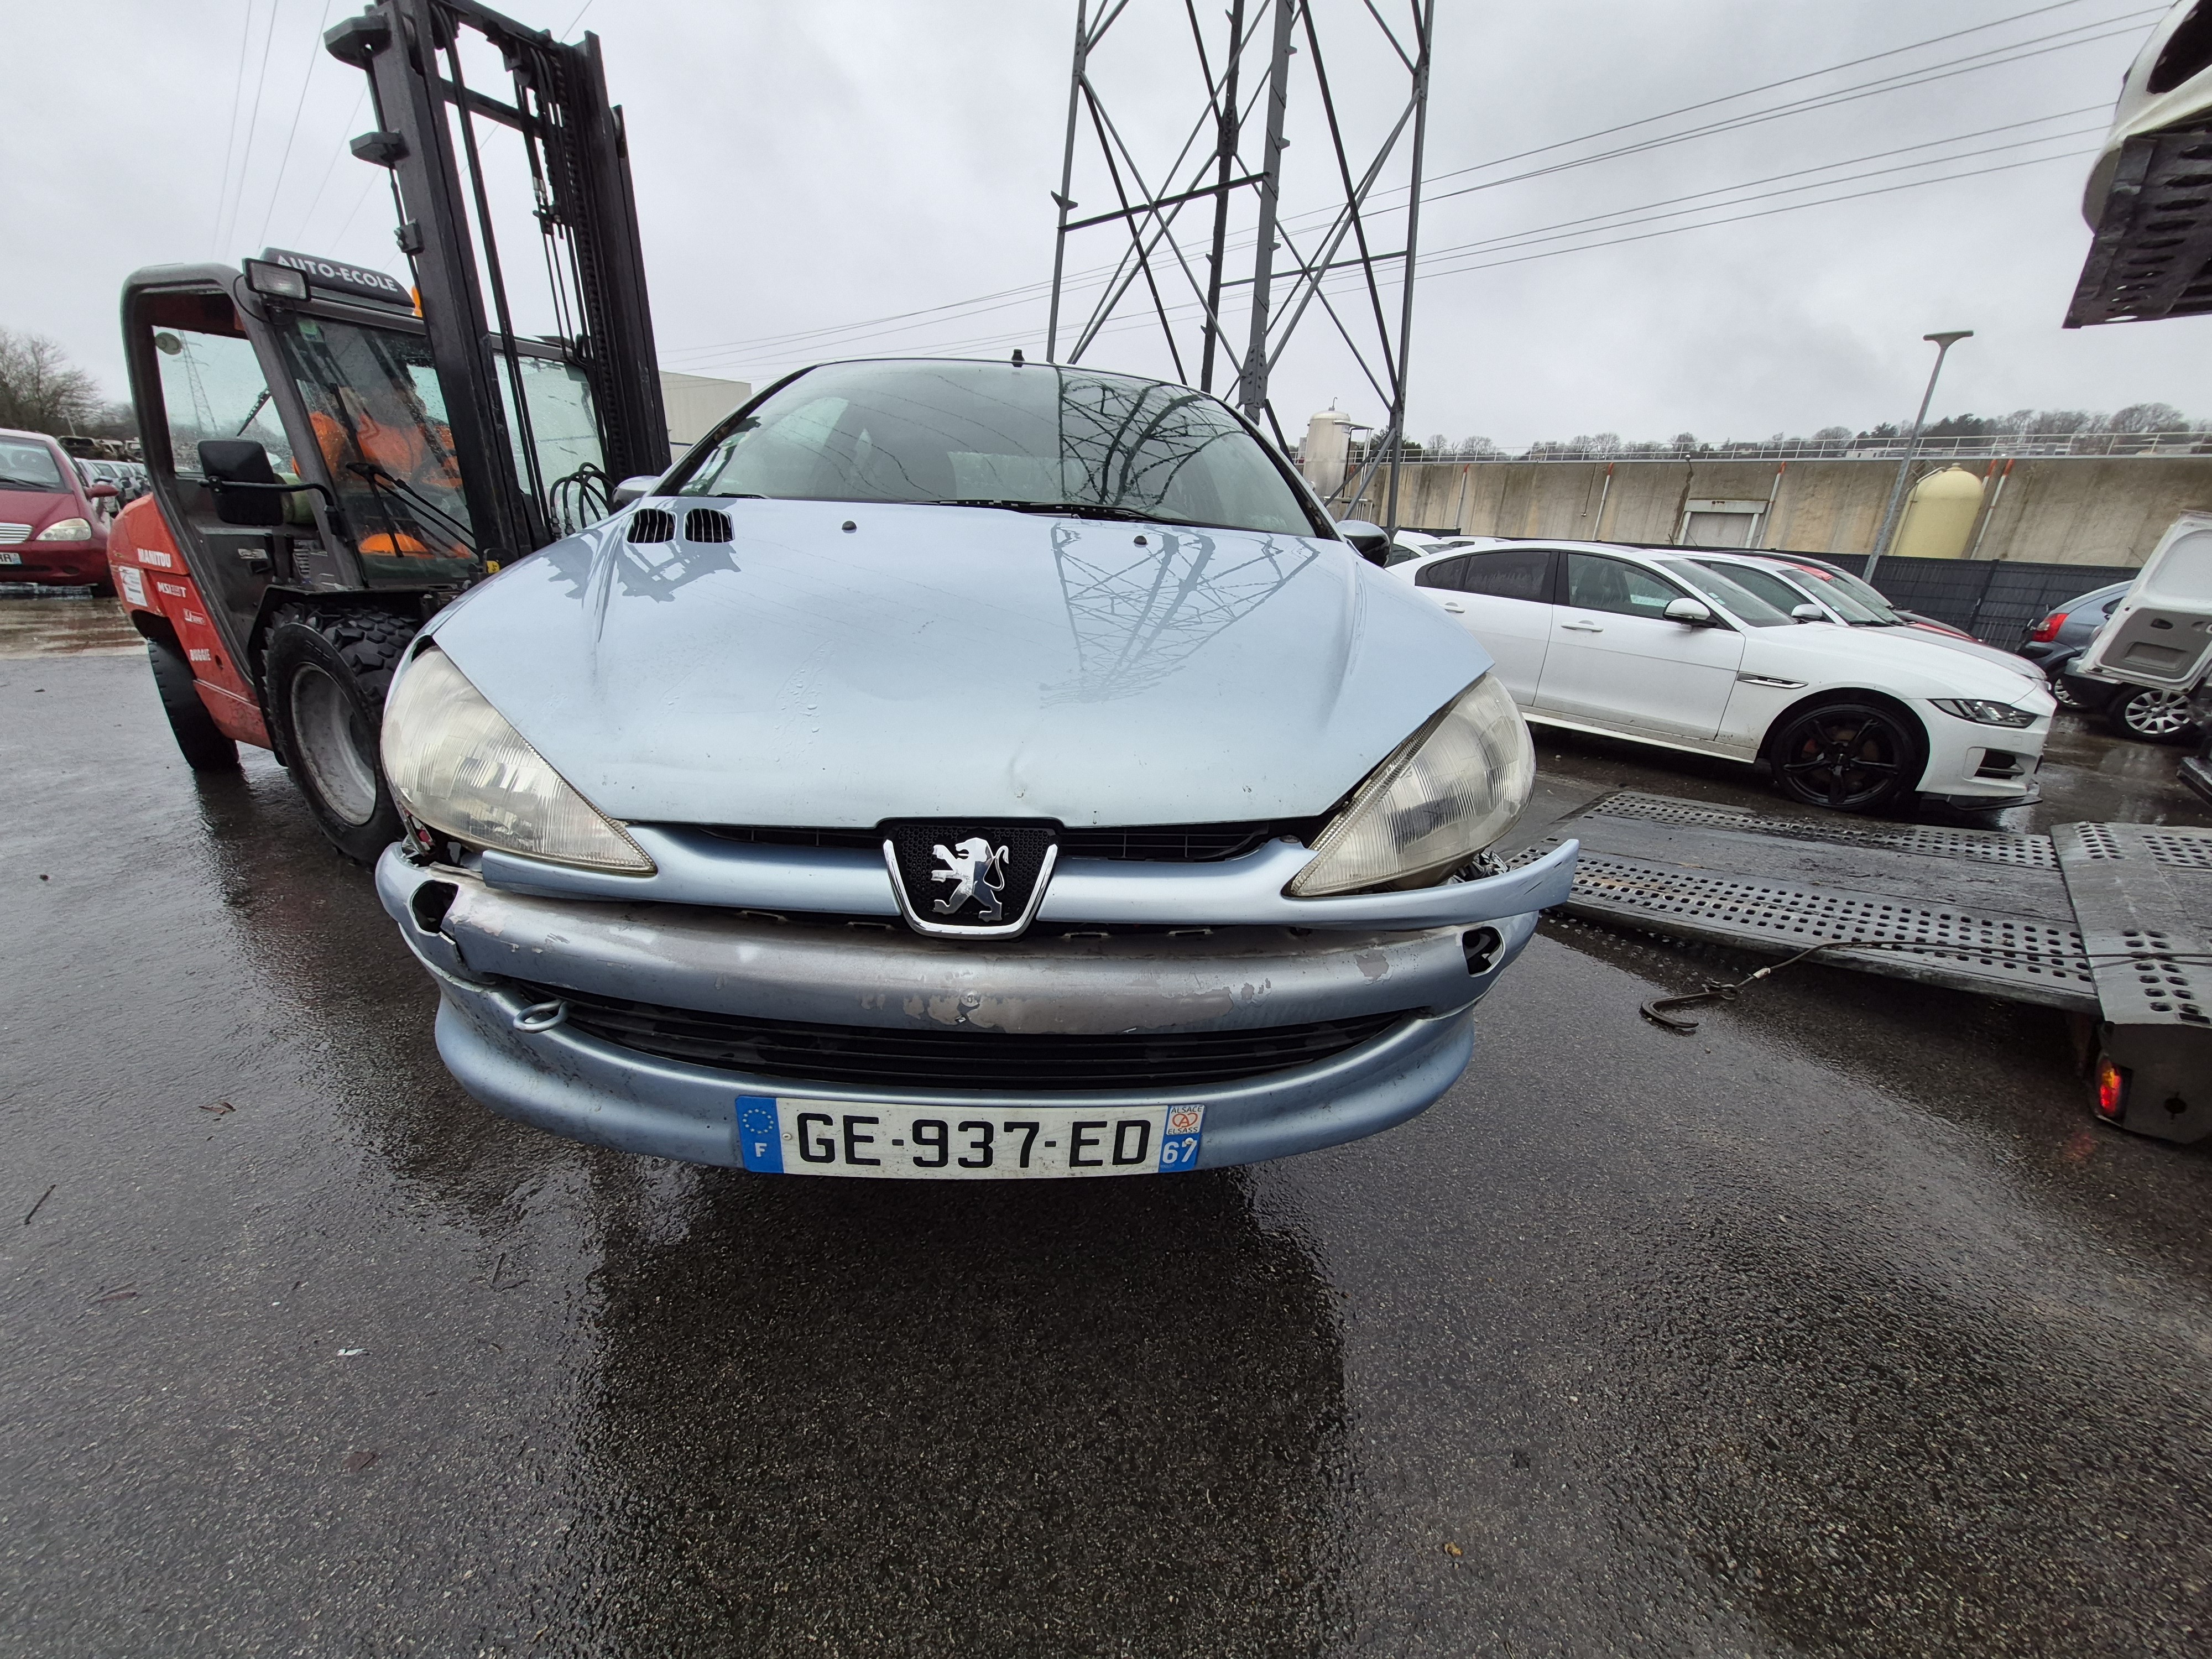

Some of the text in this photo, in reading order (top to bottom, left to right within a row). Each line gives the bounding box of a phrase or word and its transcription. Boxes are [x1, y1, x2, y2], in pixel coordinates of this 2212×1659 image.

[278, 255, 398, 292] AUTO-ECOLE
[137, 547, 171, 568] MANITOU
[754, 1142, 767, 1157] F
[797, 1112, 1152, 1168] GE-937-ED
[1162, 1140, 1197, 1164] 67
